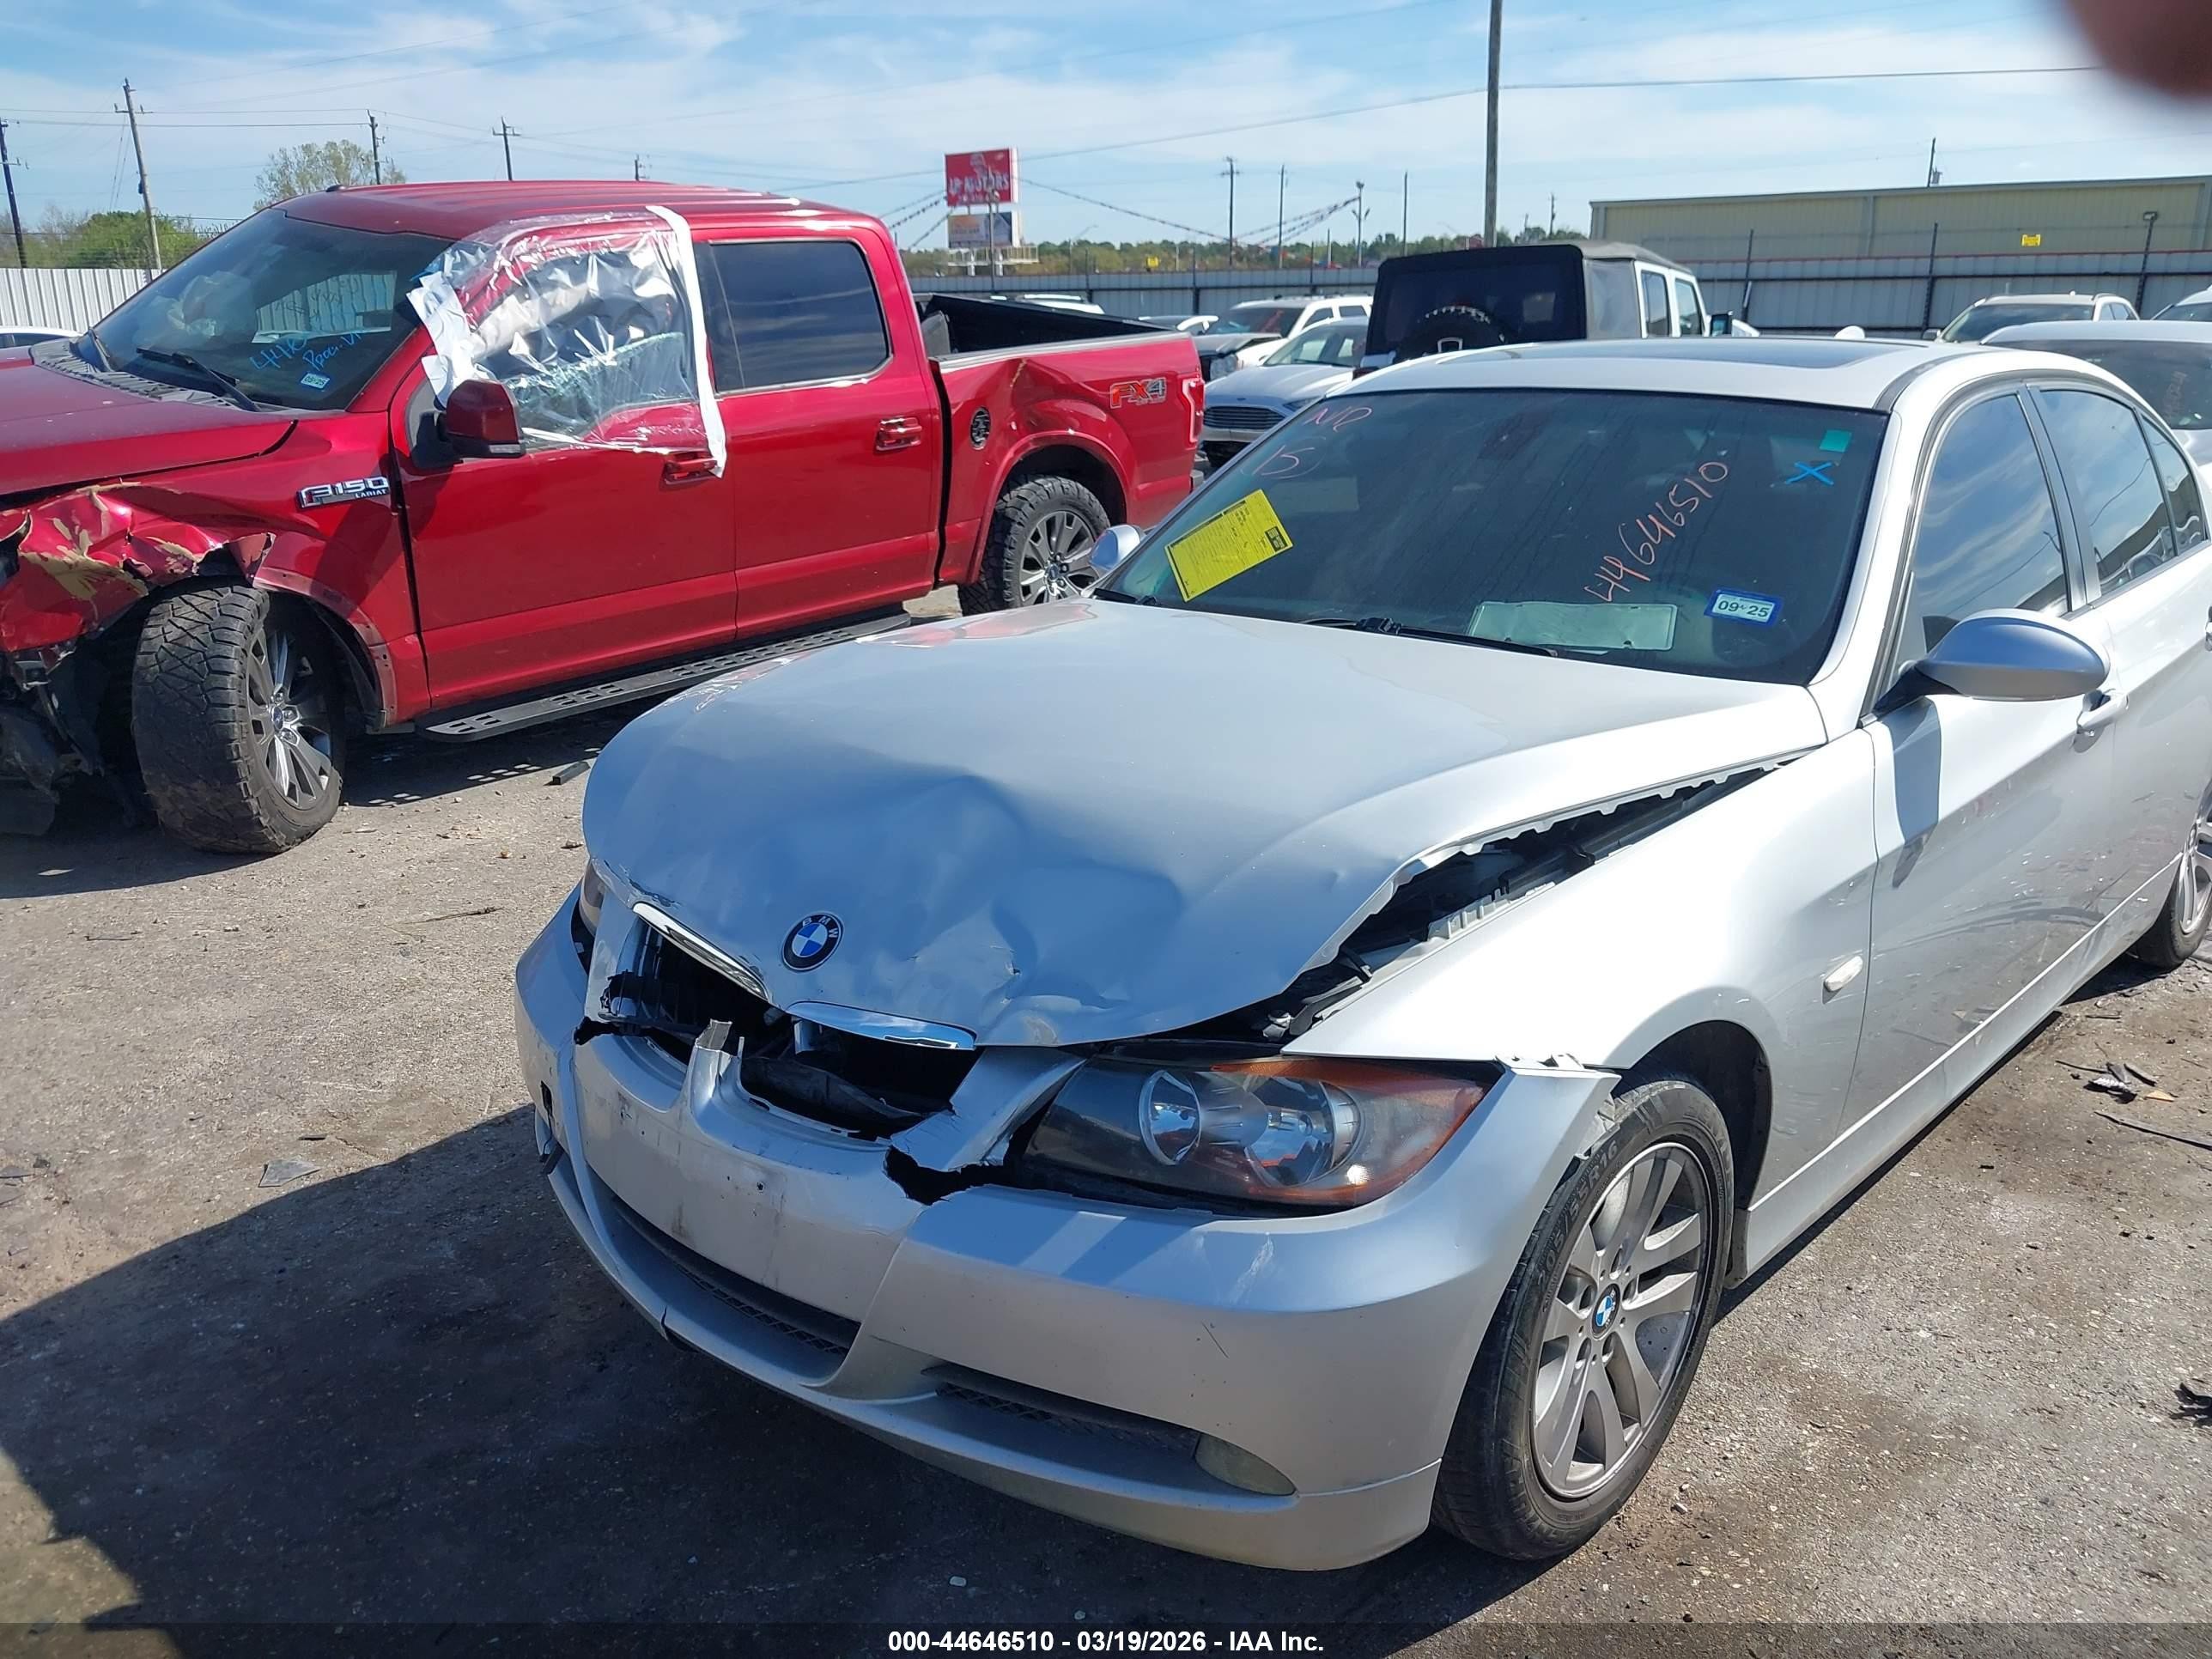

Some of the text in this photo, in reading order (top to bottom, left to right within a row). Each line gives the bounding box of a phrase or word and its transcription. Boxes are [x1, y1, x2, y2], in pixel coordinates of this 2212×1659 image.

[1110, 377, 1166, 409] FX4
[355, 489, 387, 499] LARIAT
[1583, 461, 1729, 602] 44646510
[1717, 600, 1771, 617] 09 25
